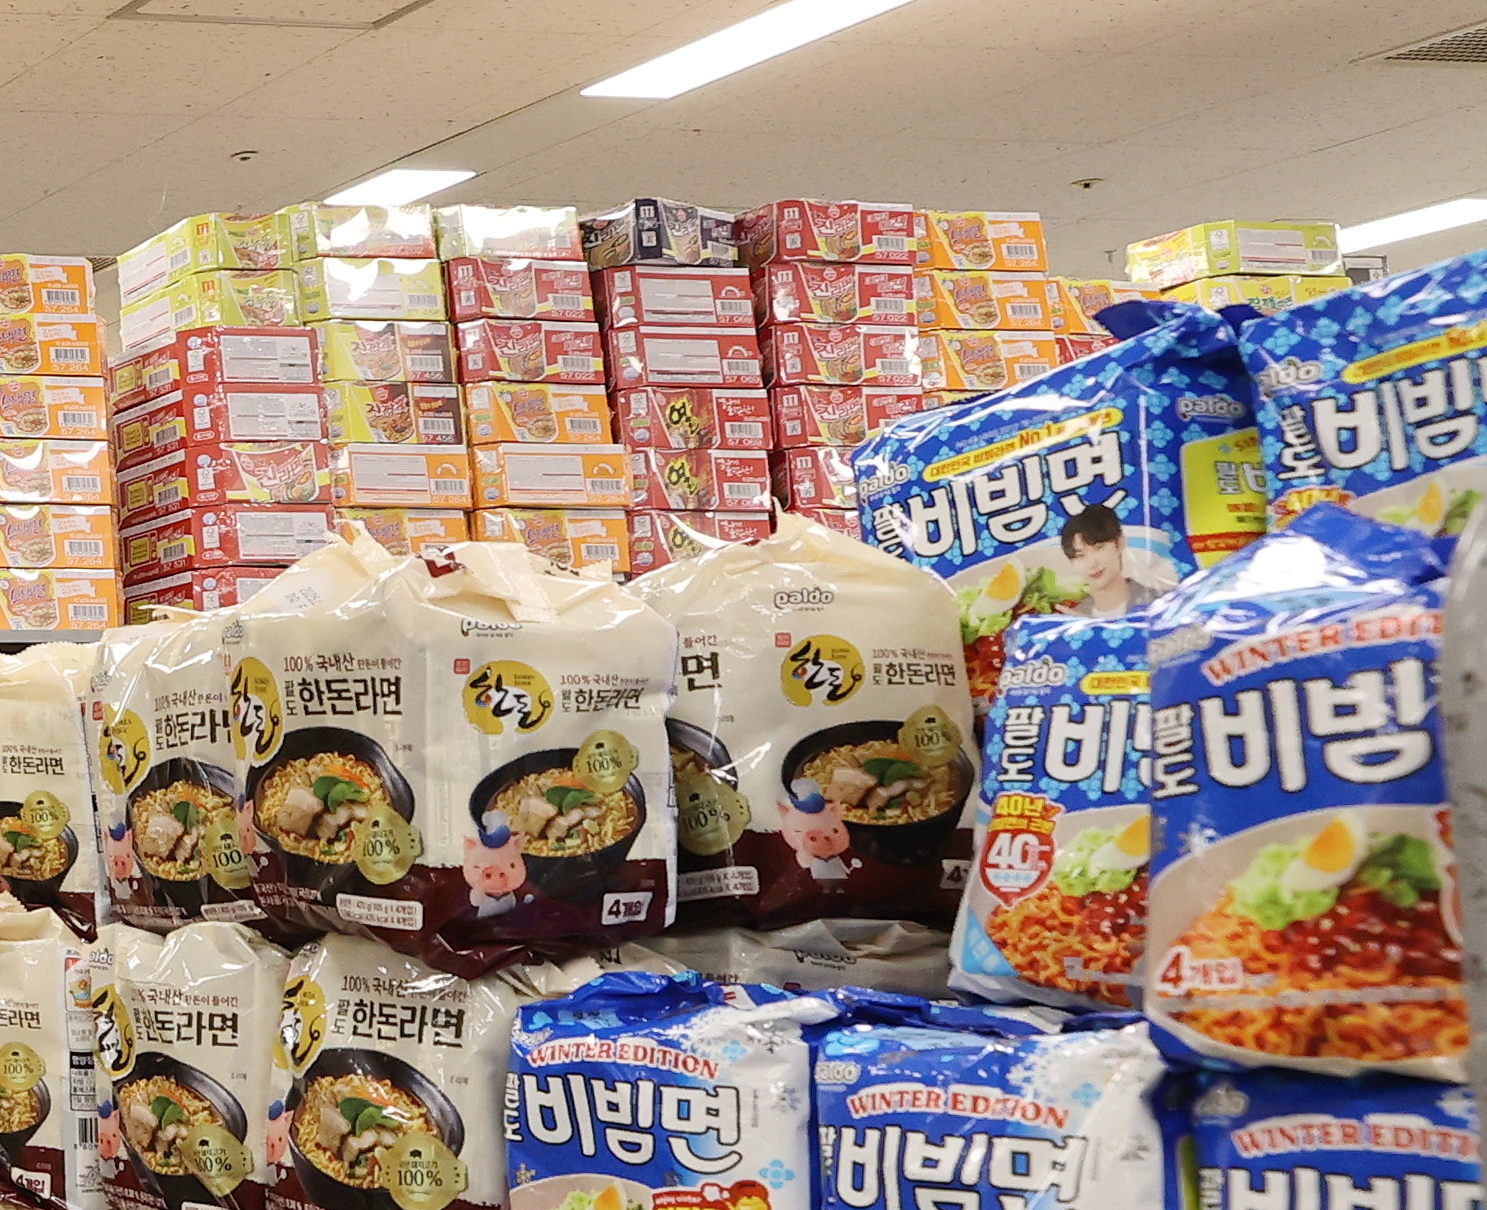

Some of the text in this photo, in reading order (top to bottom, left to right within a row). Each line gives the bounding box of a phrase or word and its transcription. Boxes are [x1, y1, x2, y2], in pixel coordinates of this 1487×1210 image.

[1278, 404, 1326, 480] 팔도
[858, 465, 909, 504] paldo
[907, 430, 1128, 557] 비빔면
[774, 588, 834, 608] paldo
[284, 654, 355, 672] 100% 국내산
[1207, 626, 1341, 682] WINTER
[560, 674, 619, 685] 100% 국내산
[885, 662, 956, 686] 한돈라면
[999, 657, 1065, 692] paldo
[299, 677, 402, 717] 한돈라면
[574, 688, 643, 712] 한돈라면
[999, 708, 1044, 783] 팔도
[1154, 706, 1199, 799] 팔도
[10, 757, 64, 775] 한돈라면
[362, 838, 400, 857] 100%
[147, 989, 185, 1006] 국내산
[343, 975, 408, 998] 100% 국내산
[141, 1008, 239, 1047] 한돈라면
[352, 1000, 465, 1049] 한돈라면
[2, 1062, 34, 1076] 100%
[528, 1041, 719, 1079] WINTER EDITION
[524, 1073, 743, 1175] 비빔면
[848, 1088, 1069, 1128] WINTER EDITION
[1234, 1116, 1359, 1157] WINTER
[397, 1169, 443, 1188] 100%
